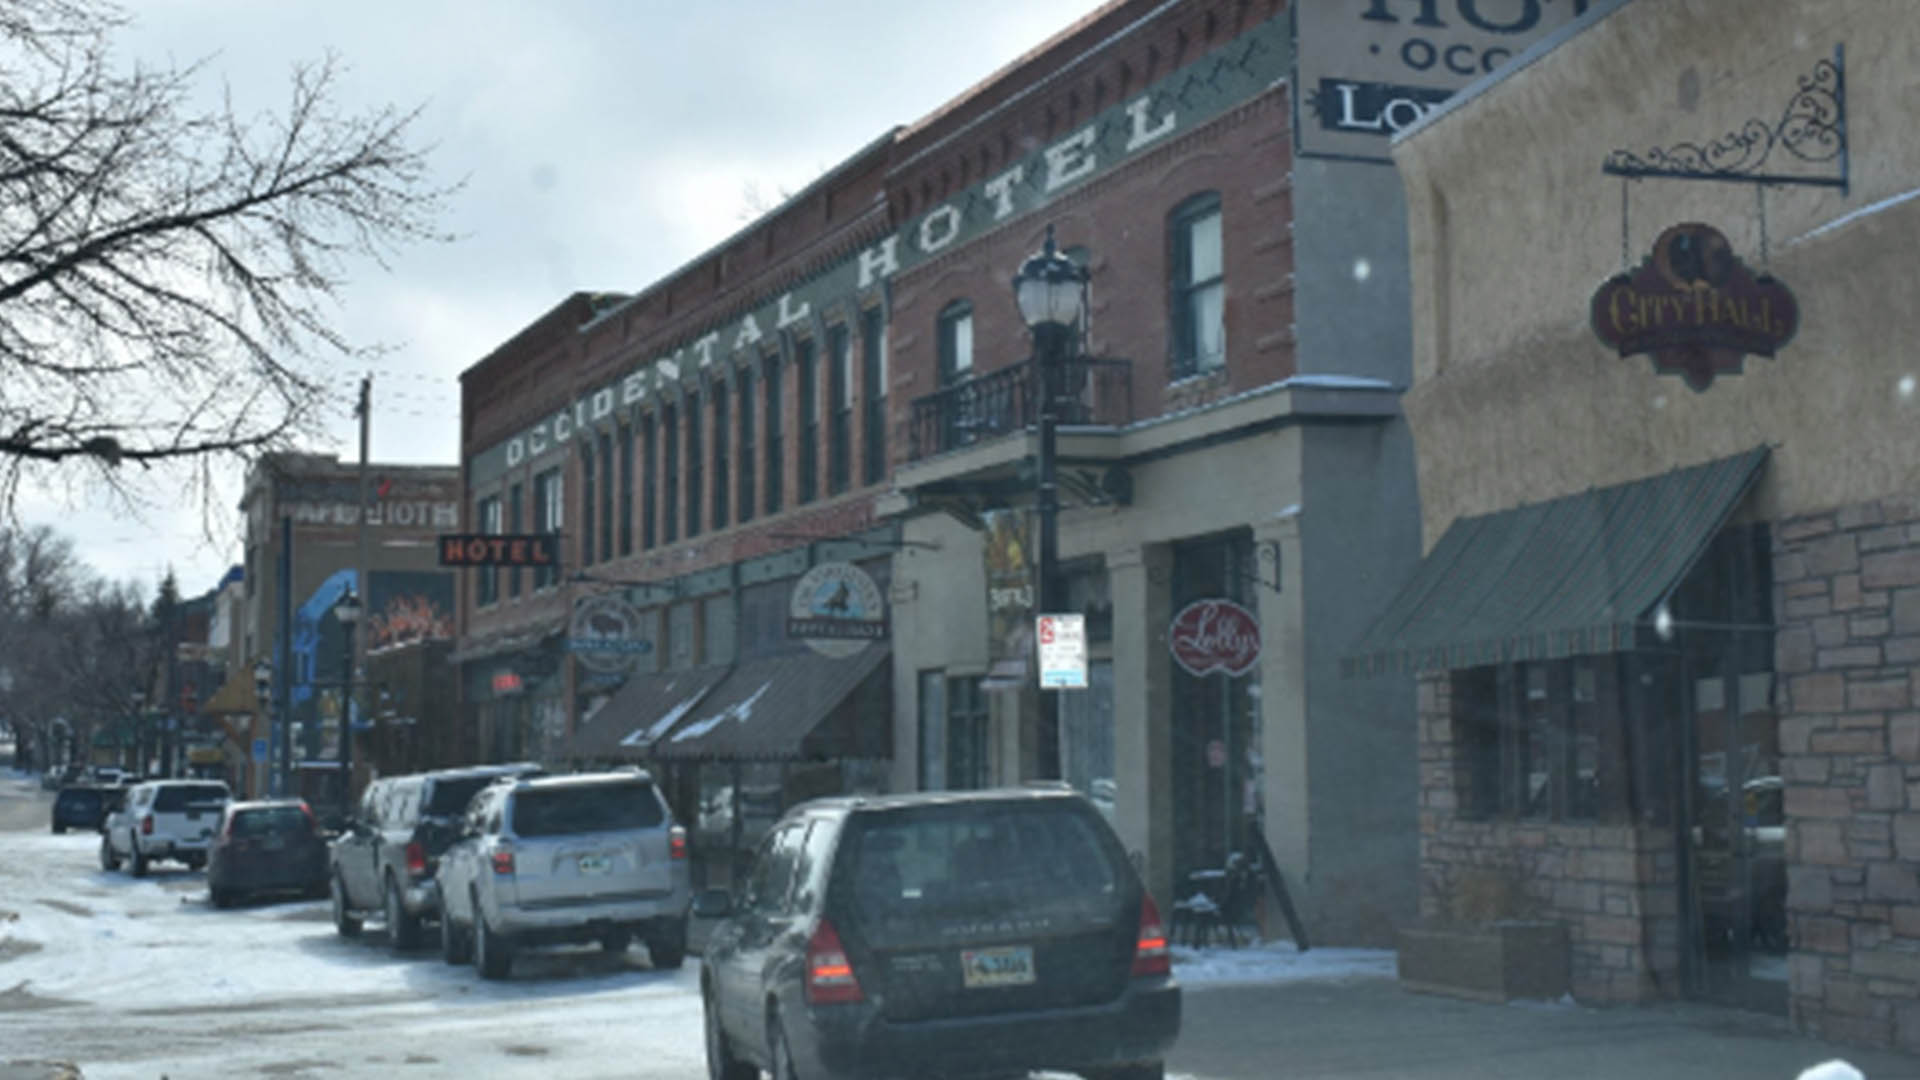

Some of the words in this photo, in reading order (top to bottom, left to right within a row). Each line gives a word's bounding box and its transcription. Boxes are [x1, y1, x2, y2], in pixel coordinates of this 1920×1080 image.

[506, 293, 810, 467] OCCIDENTAL
[857, 96, 1177, 289] HOTEL
[445, 539, 549, 564] HOTEL
